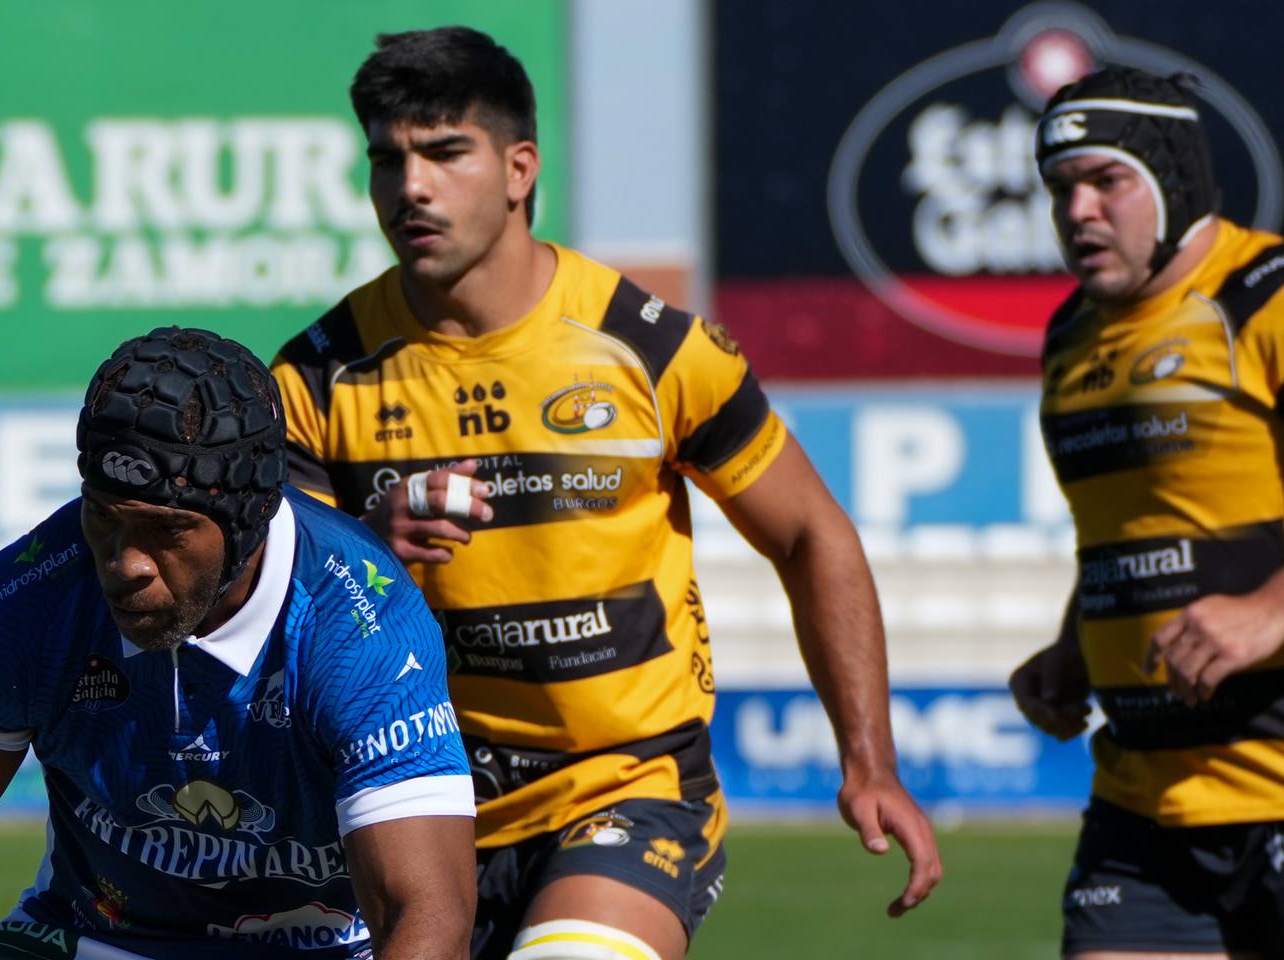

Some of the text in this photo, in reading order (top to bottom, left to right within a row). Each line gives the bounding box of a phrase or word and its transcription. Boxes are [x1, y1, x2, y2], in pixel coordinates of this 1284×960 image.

[84, 117, 372, 234] RUR
[459, 405, 511, 437] nb
[435, 455, 523, 473] HOPITAL
[484, 466, 621, 499] oletas salud
[554, 497, 619, 512] BURGOS
[324, 554, 381, 635] hidrosyplant
[456, 601, 612, 655] cajarural
[548, 646, 617, 671] Fundación
[77, 669, 119, 688] strella
[74, 796, 352, 881] ENTREPINARE
